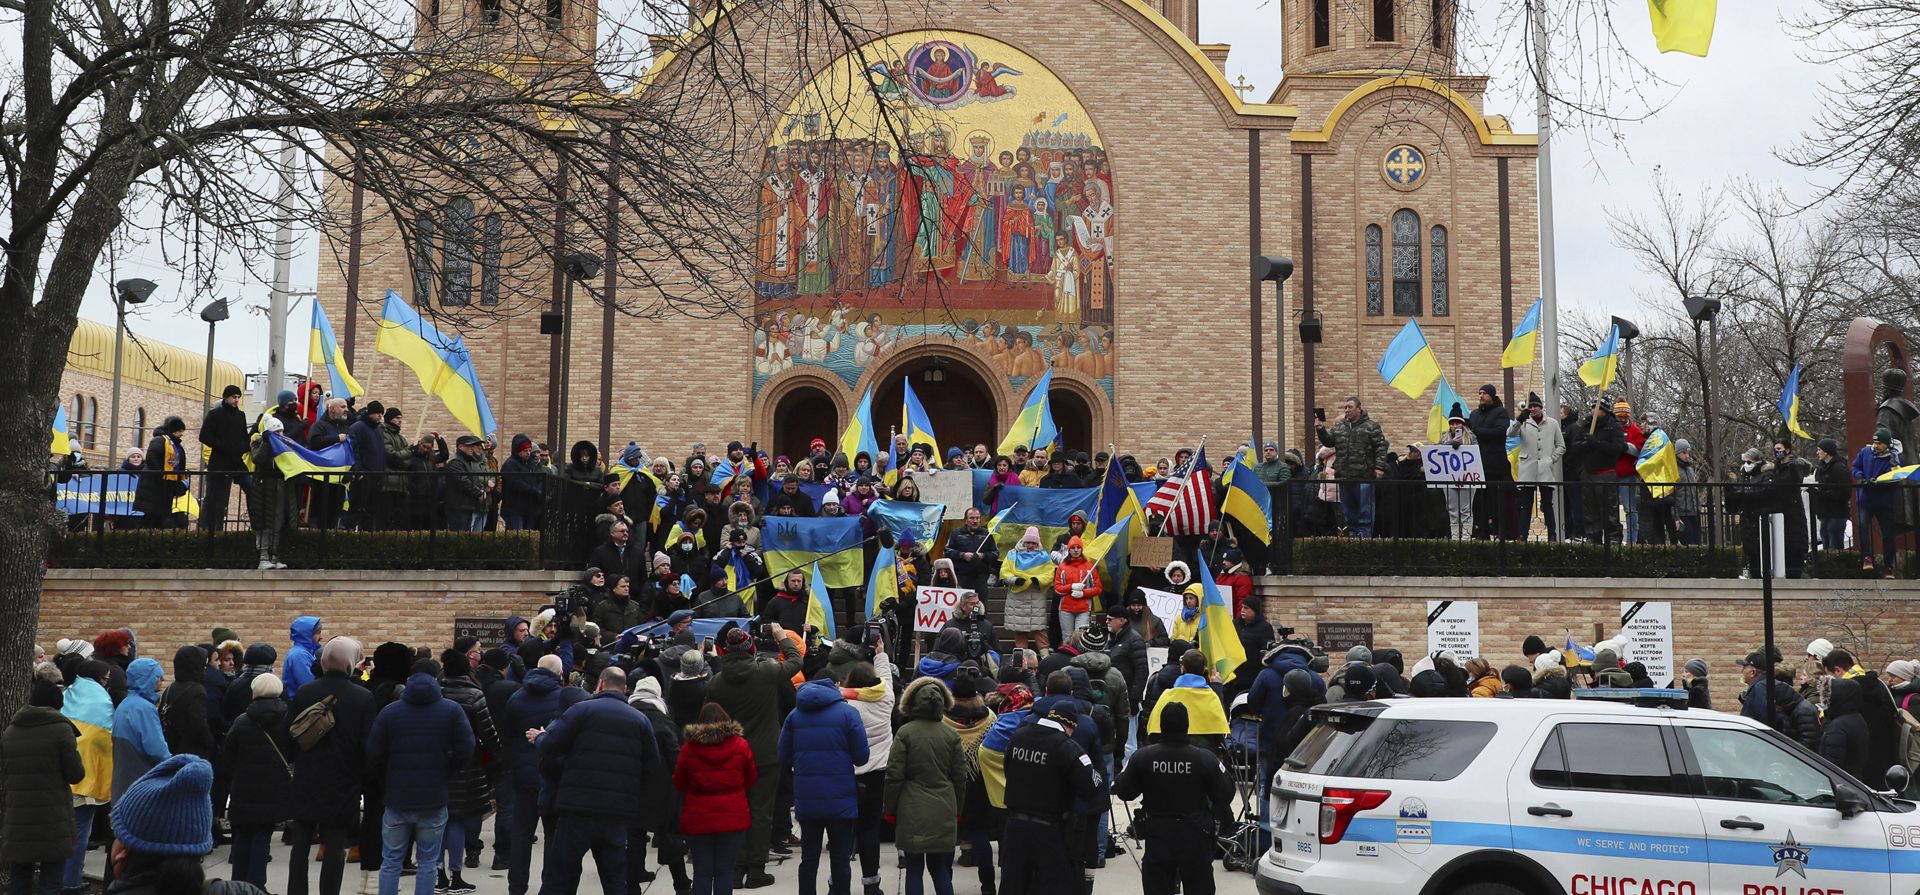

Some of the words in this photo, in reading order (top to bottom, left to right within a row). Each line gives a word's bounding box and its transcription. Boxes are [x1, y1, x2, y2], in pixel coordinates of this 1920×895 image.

[1427, 448, 1474, 475] STOP
[920, 590, 958, 606] STO
[917, 608, 955, 628] WA
[1012, 746, 1048, 765] POLICE
[1152, 760, 1192, 774] POLICE
[1578, 838, 1592, 847] WE
[1596, 840, 1624, 850] SERVE
[1628, 842, 1646, 851] AND
[1650, 844, 1690, 854] PROTECT
[1775, 850, 1806, 861] CAPS
[1572, 874, 1696, 895] CHICAGO
